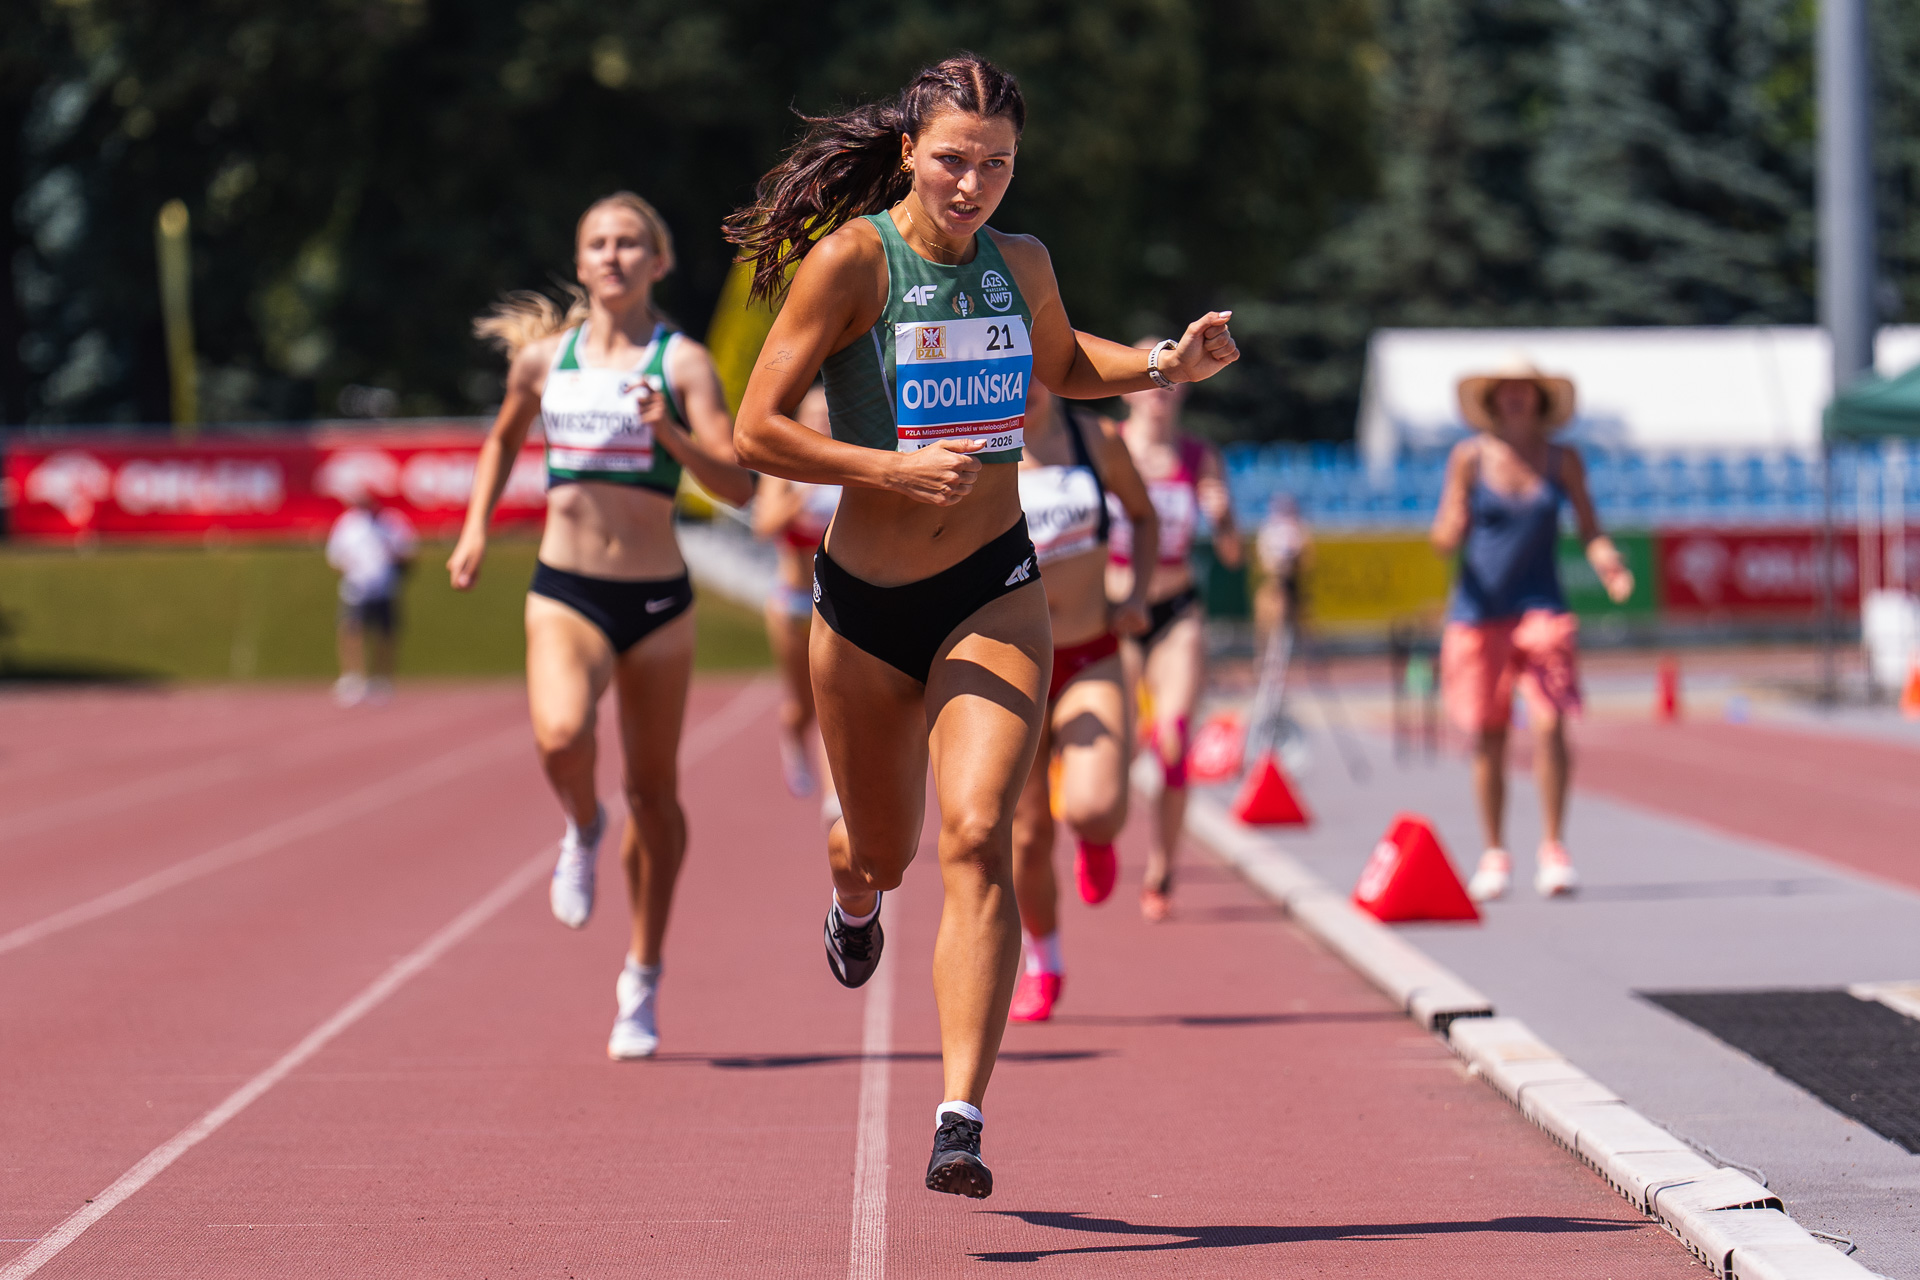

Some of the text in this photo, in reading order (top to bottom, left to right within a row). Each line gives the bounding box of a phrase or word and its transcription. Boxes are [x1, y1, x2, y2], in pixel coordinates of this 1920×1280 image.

[986, 277, 1002, 287] AZS
[902, 284, 938, 306] 4F
[990, 292, 1009, 304] AWF
[986, 324, 1014, 351] 21
[918, 348, 944, 359] PZLA
[902, 368, 1023, 410] ODOLIŃSKA
[922, 428, 954, 436] Mistrzostwa
[955, 425, 972, 433] Polski
[978, 423, 1009, 433] wielobojach
[990, 435, 1013, 448] 2026
[1004, 556, 1032, 587] 4F
